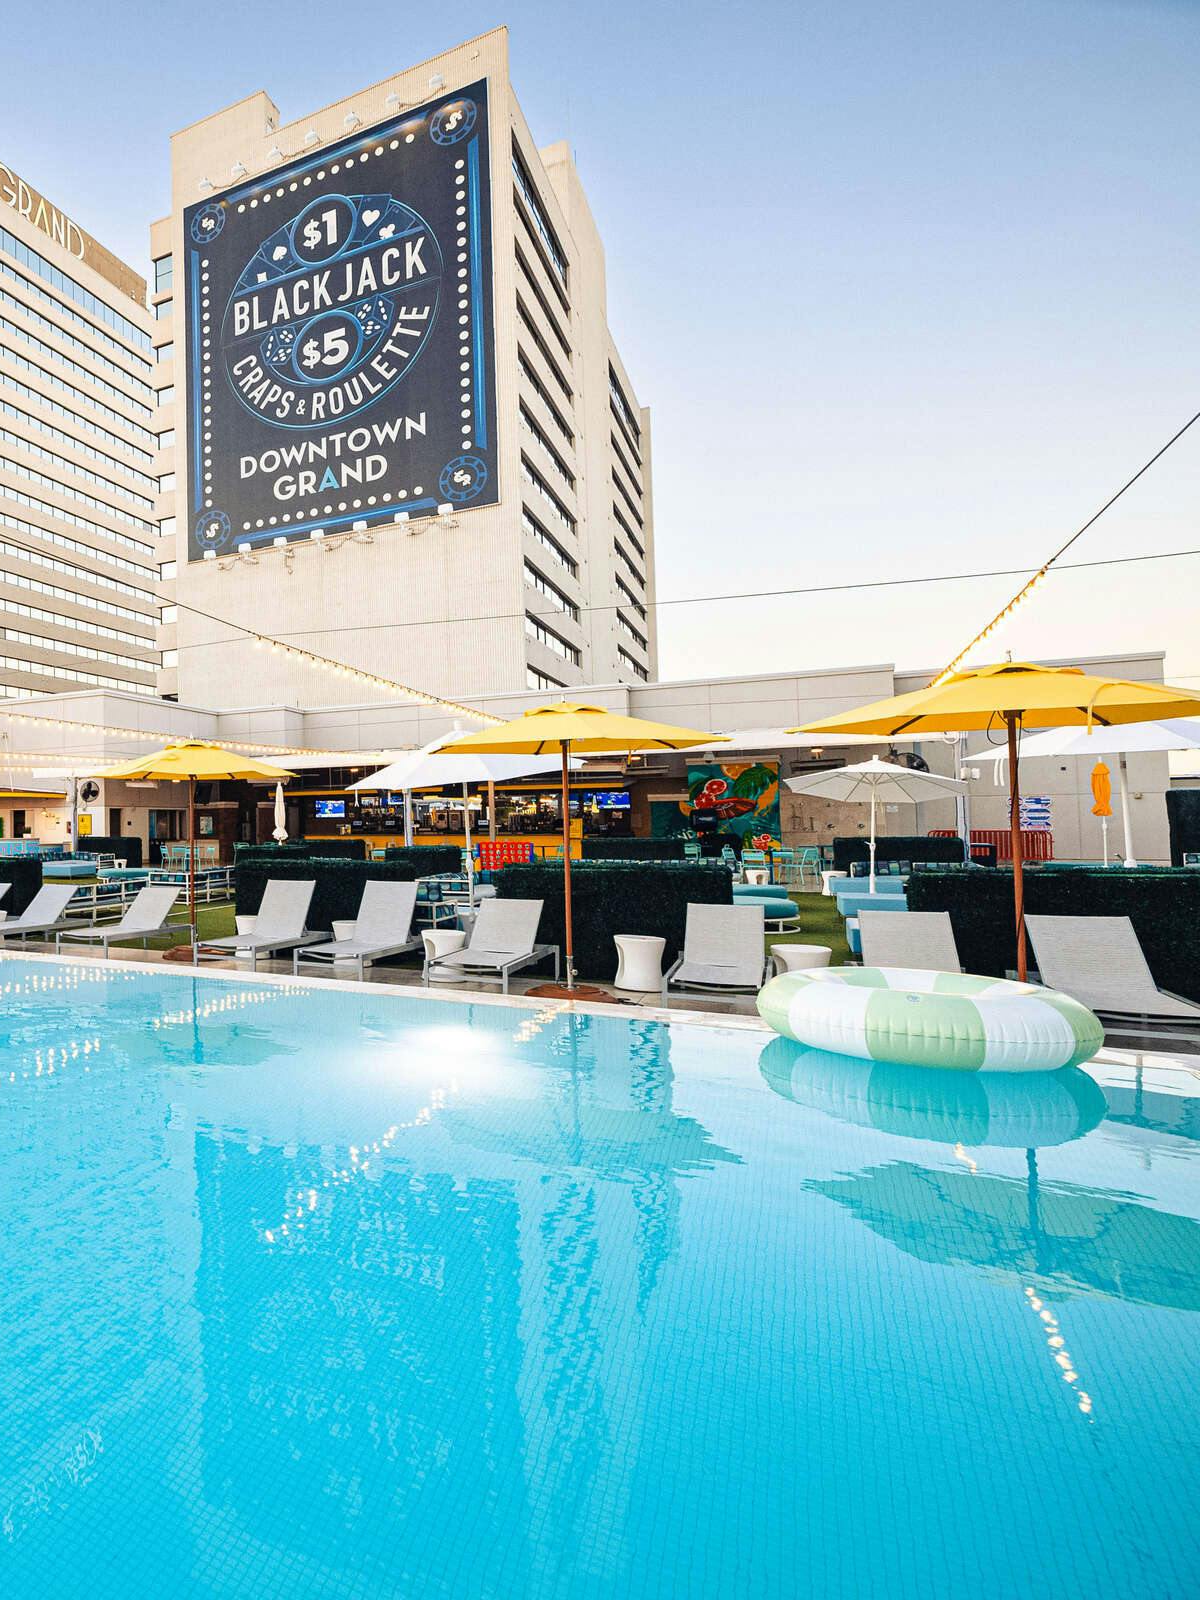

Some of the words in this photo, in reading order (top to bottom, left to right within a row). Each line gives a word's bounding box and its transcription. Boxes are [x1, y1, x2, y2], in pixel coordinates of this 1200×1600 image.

[303, 209, 338, 250] $1
[232, 354, 295, 419] CRAPS
[295, 398, 307, 416] &
[311, 305, 431, 421] ROULETTE
[302, 327, 350, 369] $5
[239, 411, 427, 479] DOWNTOWN
[273, 454, 389, 501] GRAND
